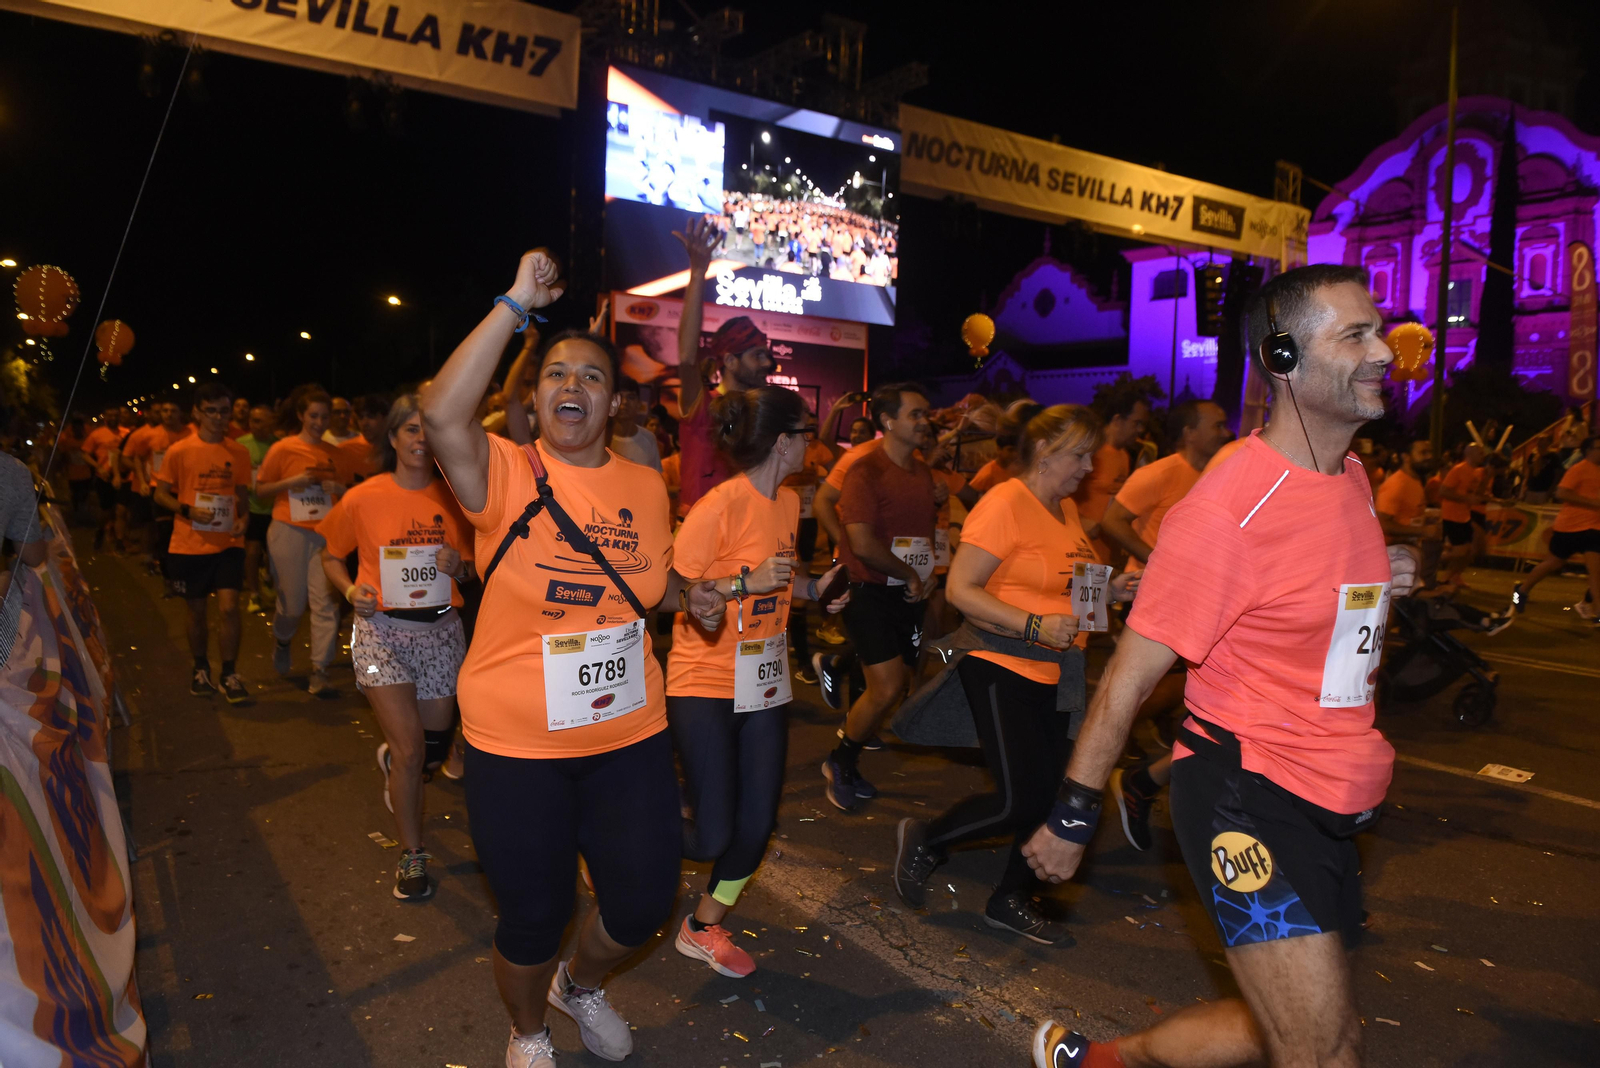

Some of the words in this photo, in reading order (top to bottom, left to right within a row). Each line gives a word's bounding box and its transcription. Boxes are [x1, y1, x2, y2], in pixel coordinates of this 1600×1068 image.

[905, 132, 1041, 187] NOCTURNA
[1046, 168, 1133, 208] SEVILLA
[583, 523, 639, 541] NOCTURNA
[902, 553, 929, 566] 15125
[401, 566, 437, 582] 3069
[578, 656, 626, 686] 6789
[758, 658, 783, 681] 6790
